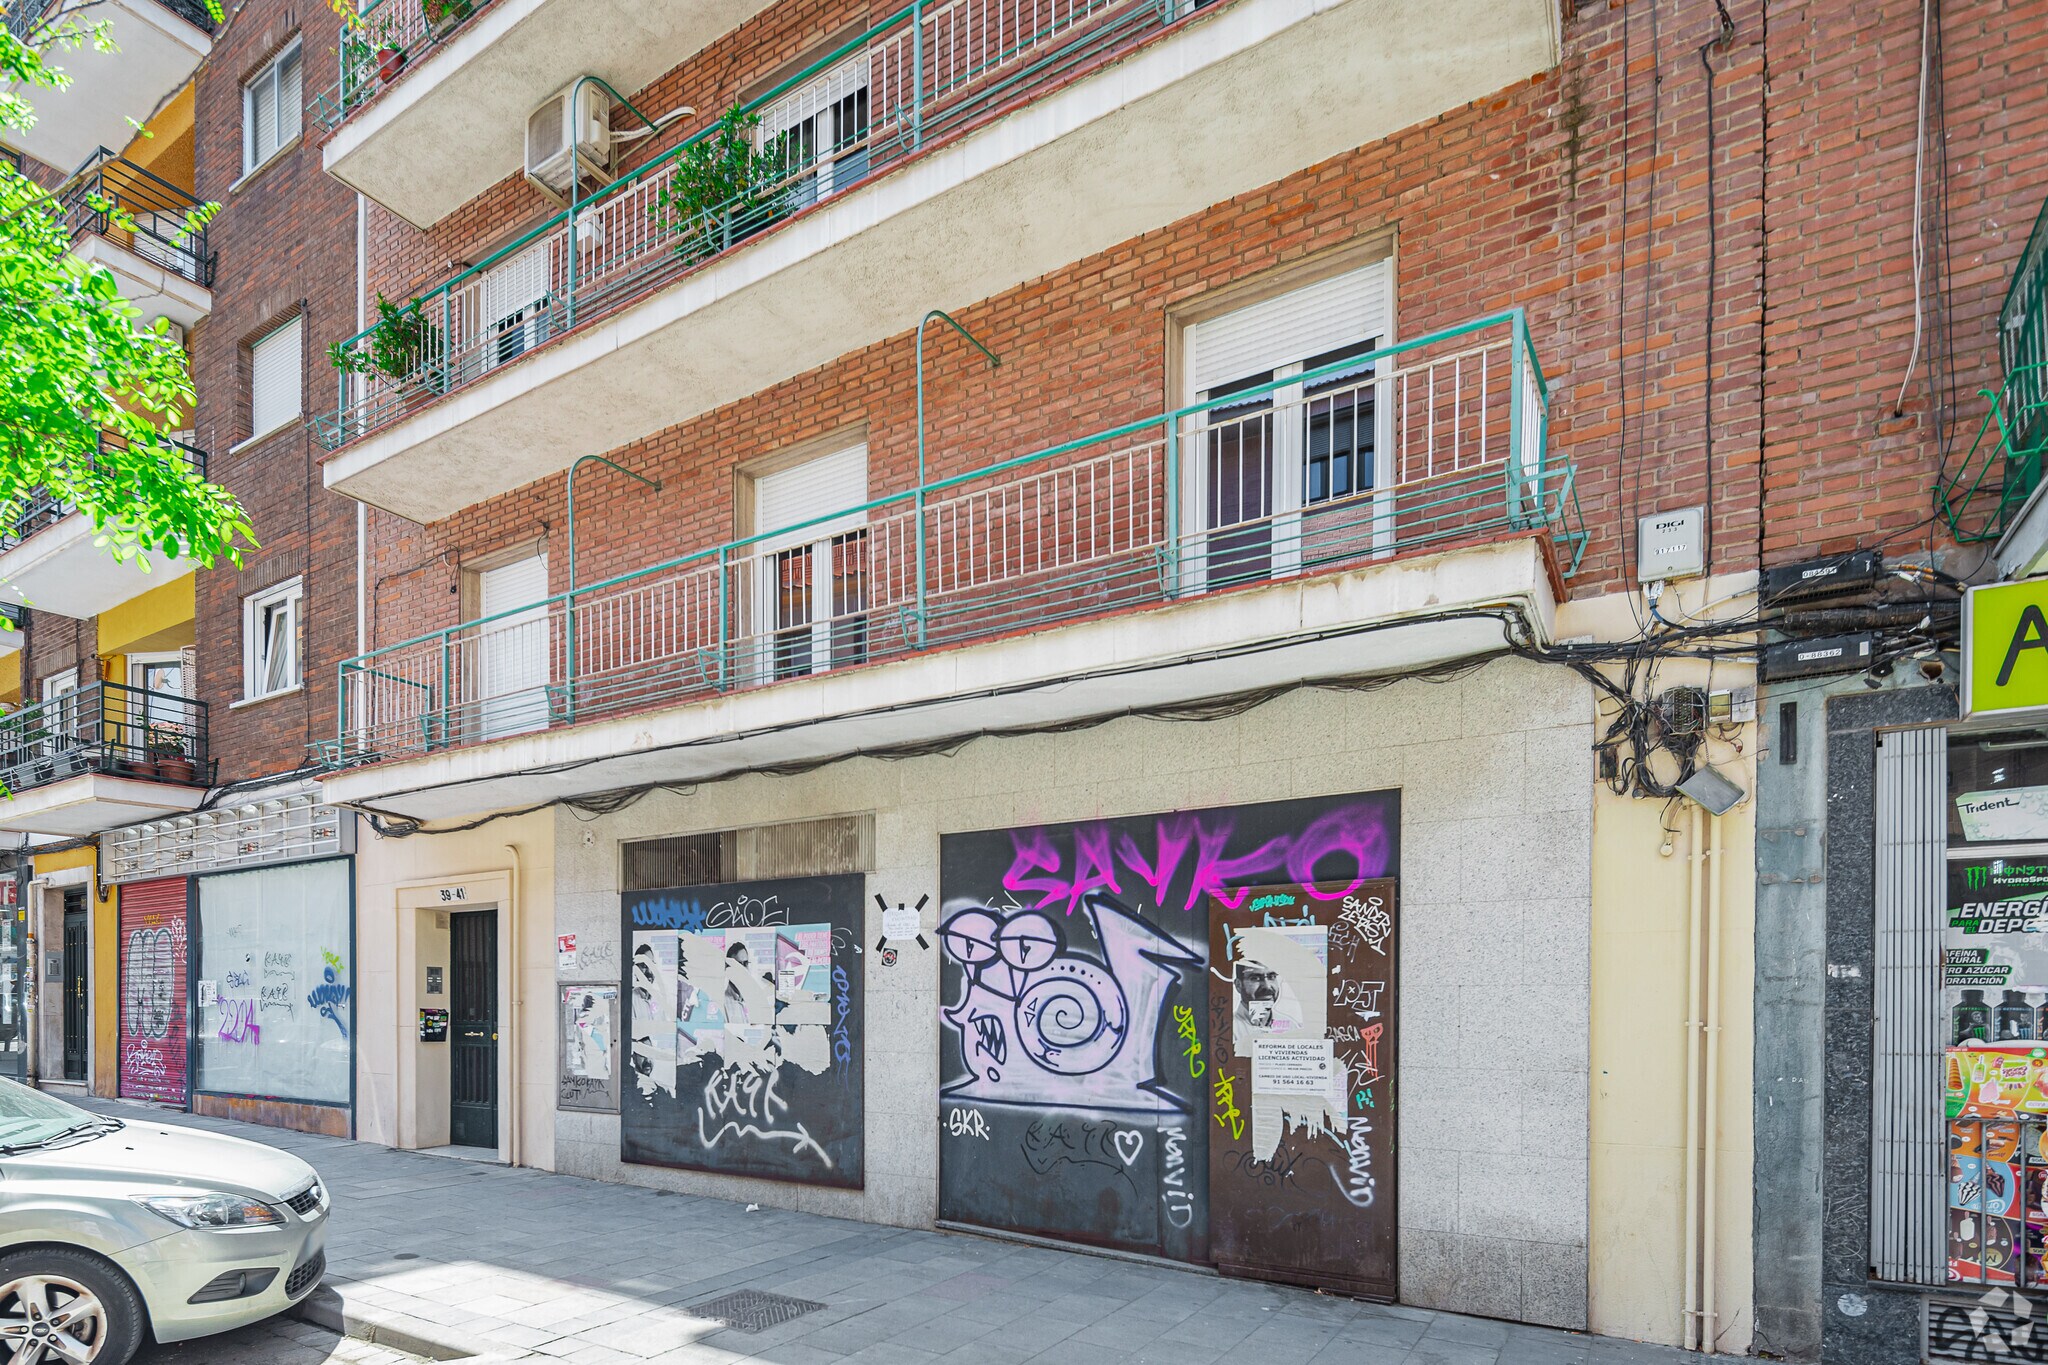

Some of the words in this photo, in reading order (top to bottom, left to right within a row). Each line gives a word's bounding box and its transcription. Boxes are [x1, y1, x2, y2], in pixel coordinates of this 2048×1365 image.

[1656, 520, 1684, 530] DIGI
[1996, 604, 2048, 687] A
[1958, 797, 2020, 814] Trident
[1951, 919, 1979, 927] PARA
[1946, 966, 1963, 974] RO
[1965, 964, 2009, 974] AZÚCAR
